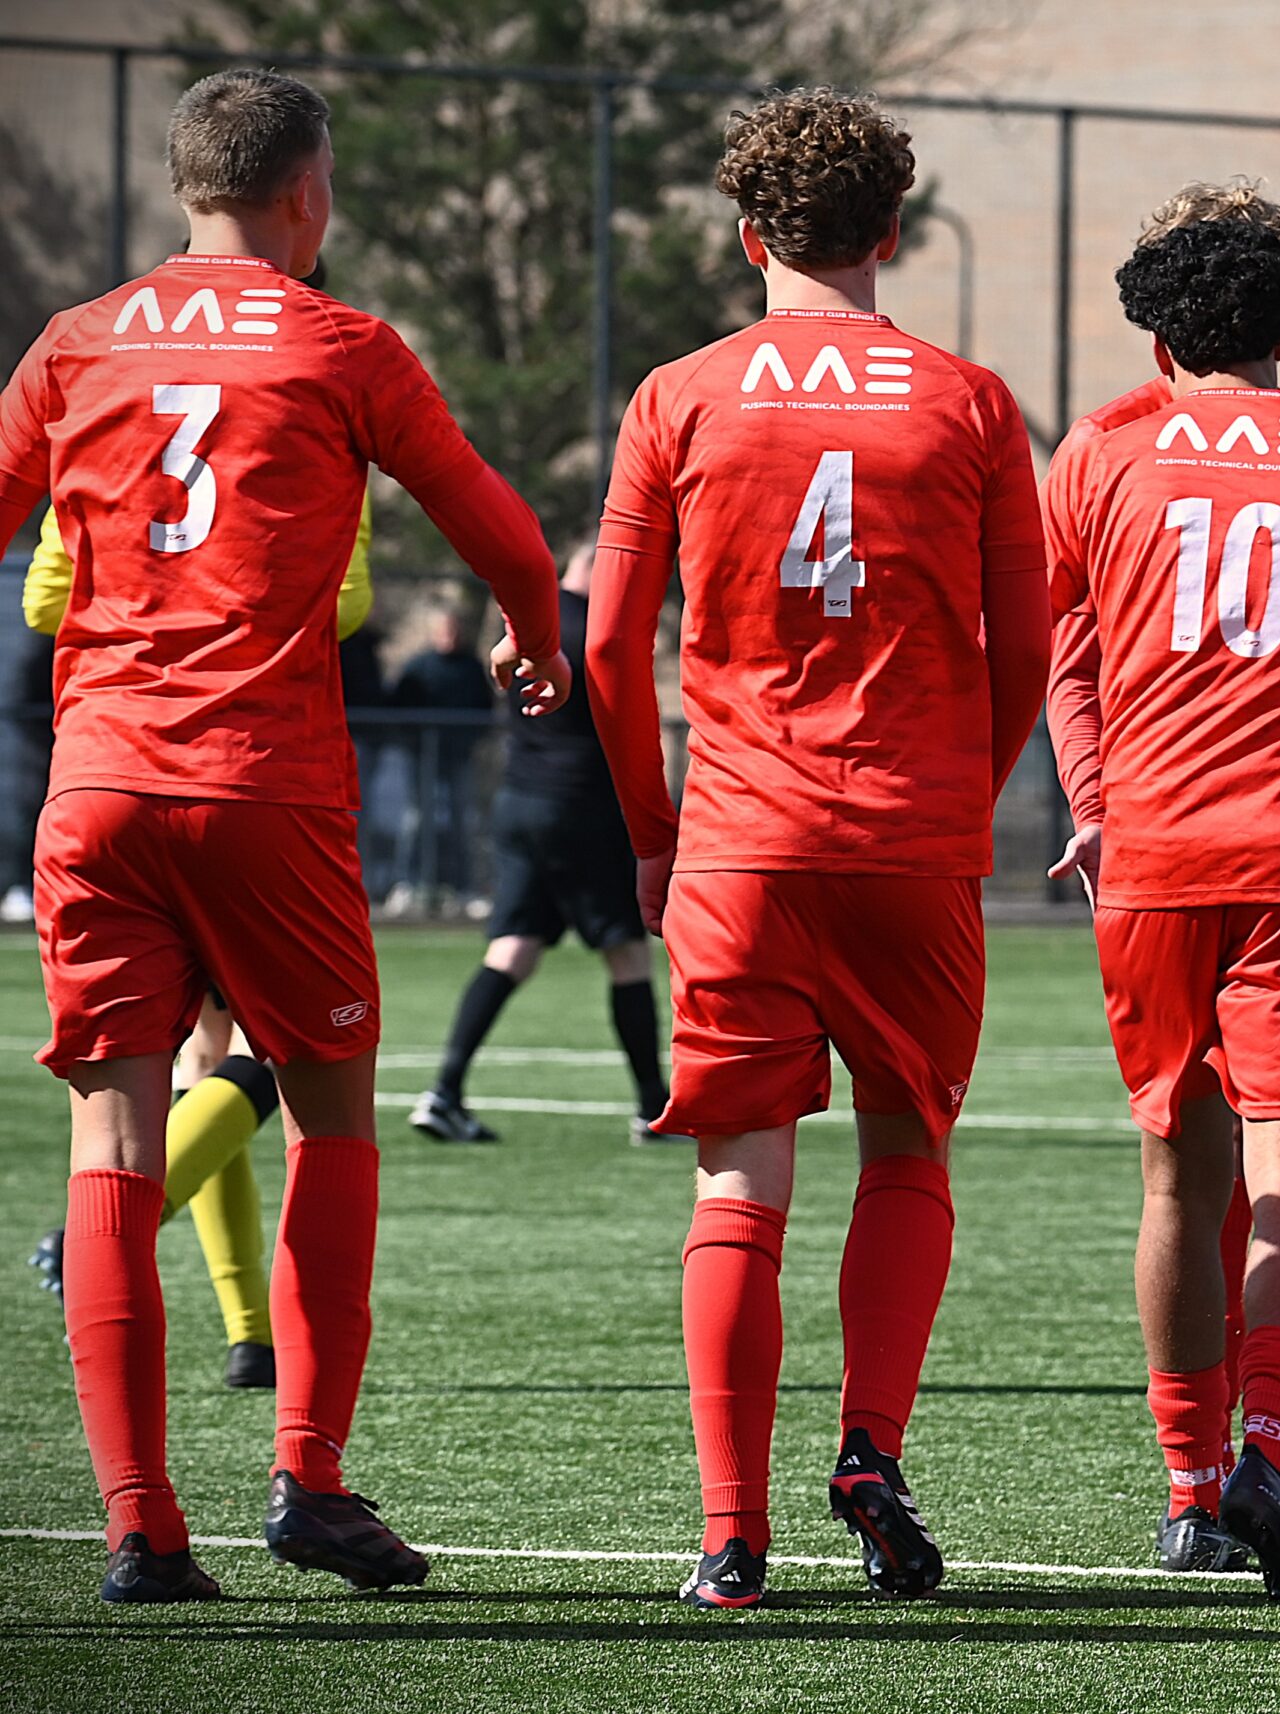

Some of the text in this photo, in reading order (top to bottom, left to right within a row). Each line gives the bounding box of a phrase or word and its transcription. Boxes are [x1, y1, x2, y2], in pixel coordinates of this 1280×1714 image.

[848, 313, 875, 321] BENDE
[111, 342, 273, 352] PUSHING TECHNICAL BOUNDARIES
[740, 400, 911, 412] PUSHING TECHNICAL BOUNDARIES
[149, 384, 222, 553] 3
[1155, 458, 1198, 466] PUSHING
[1200, 459, 1255, 470] TECHNICAL
[779, 450, 866, 617] 4
